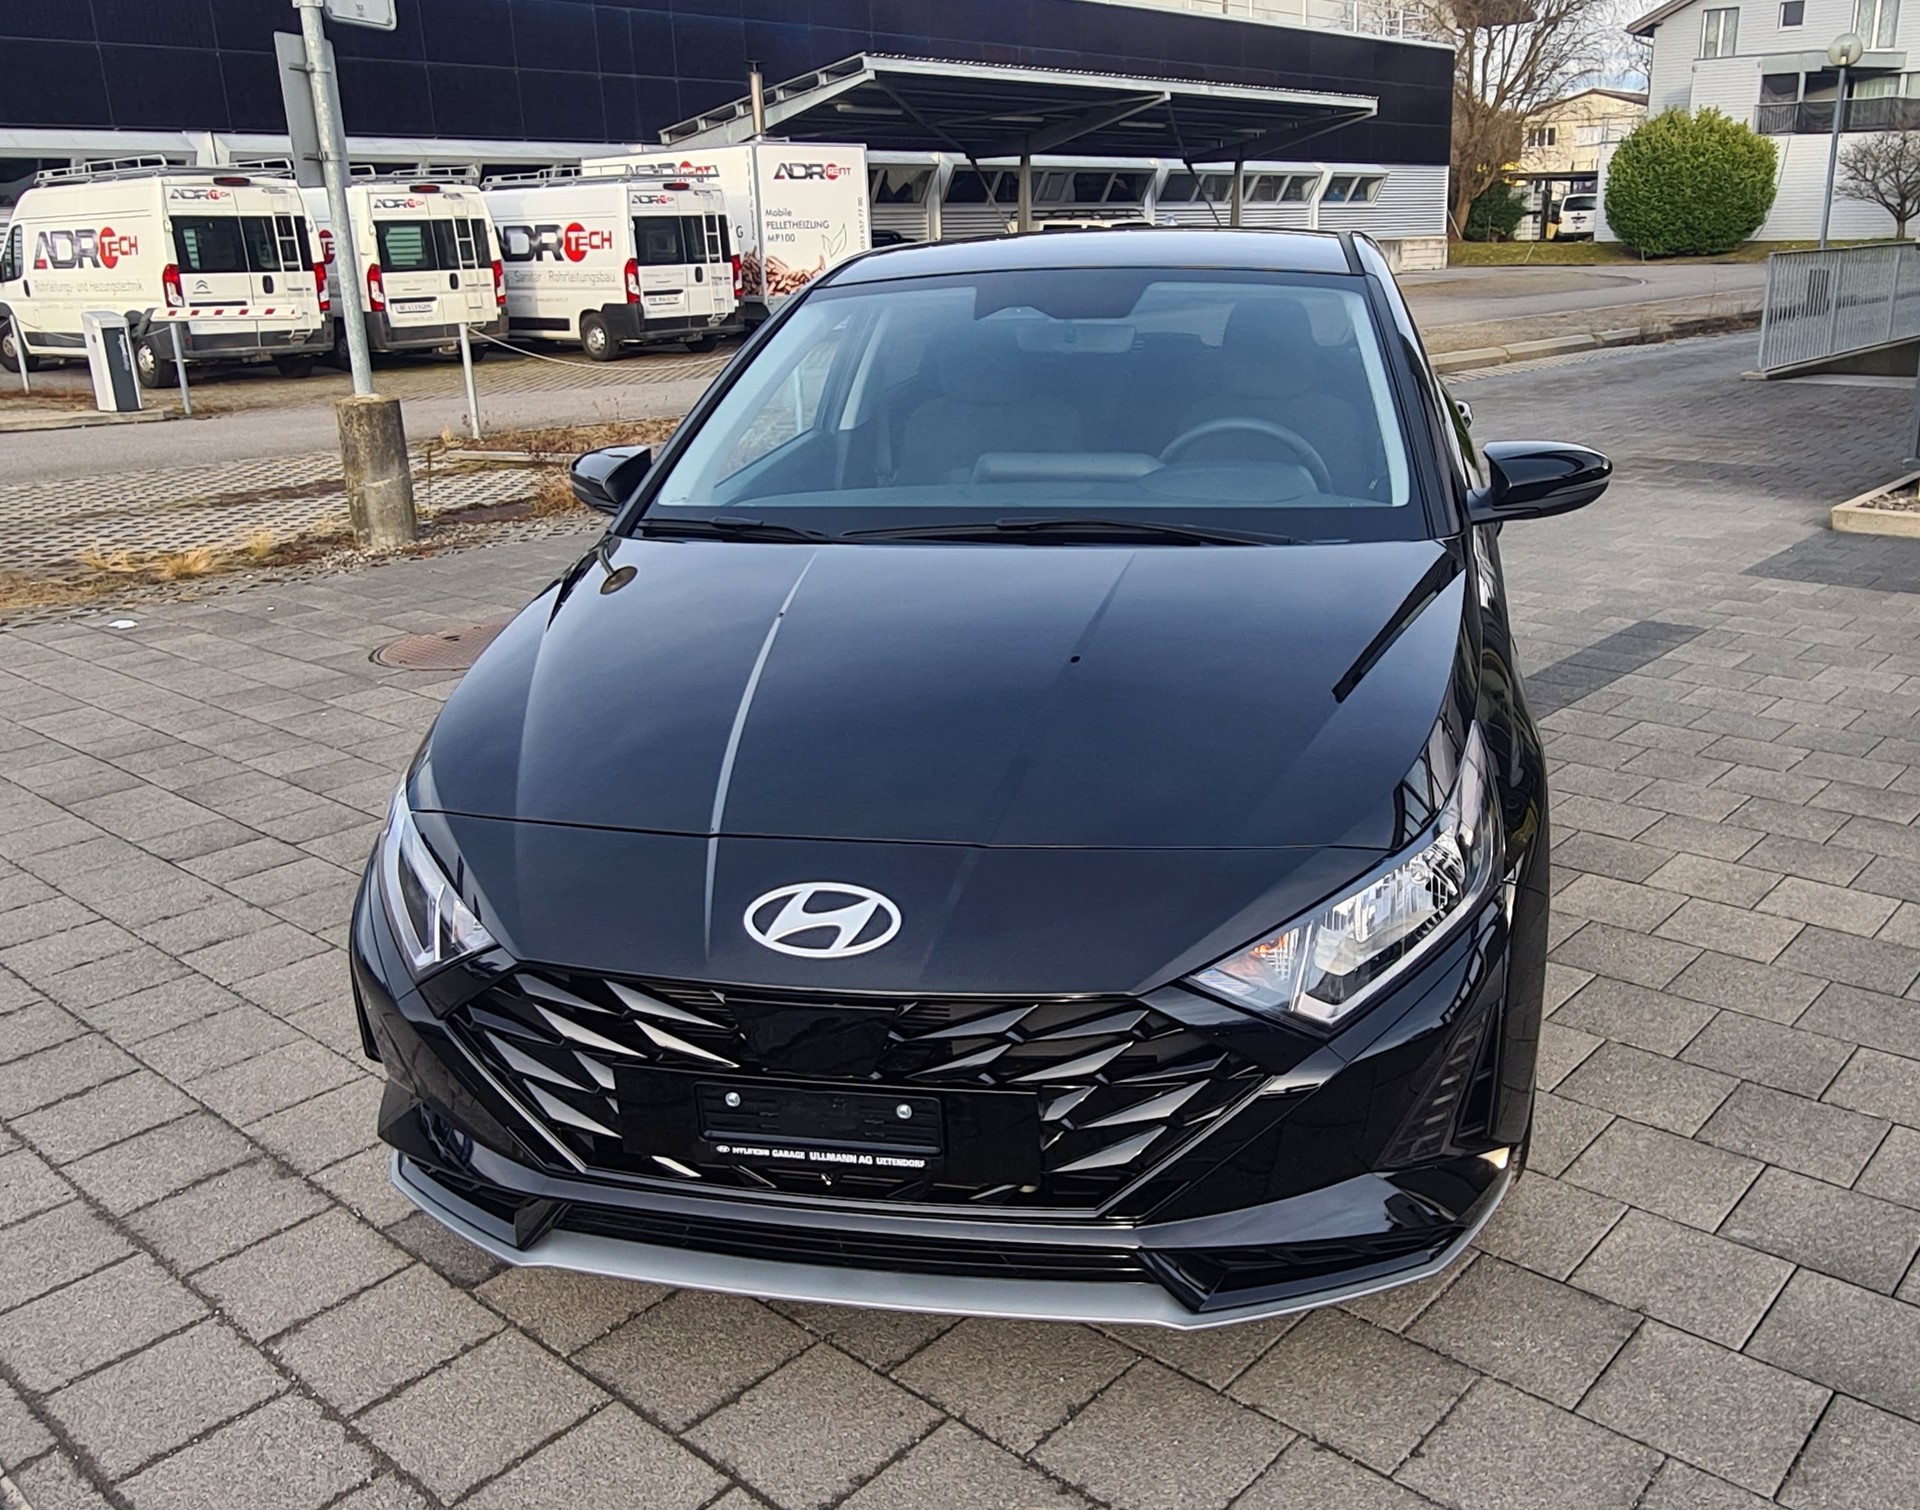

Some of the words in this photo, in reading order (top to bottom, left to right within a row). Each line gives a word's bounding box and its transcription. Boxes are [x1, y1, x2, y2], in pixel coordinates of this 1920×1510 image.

[765, 208, 792, 217] Mobile
[766, 220, 830, 230] PELLETHEIZUNG
[767, 233, 796, 243] MP100
[772, 1149, 806, 1160] GARAGE
[809, 1152, 857, 1164] ULLMANN
[858, 1155, 873, 1165] AG
